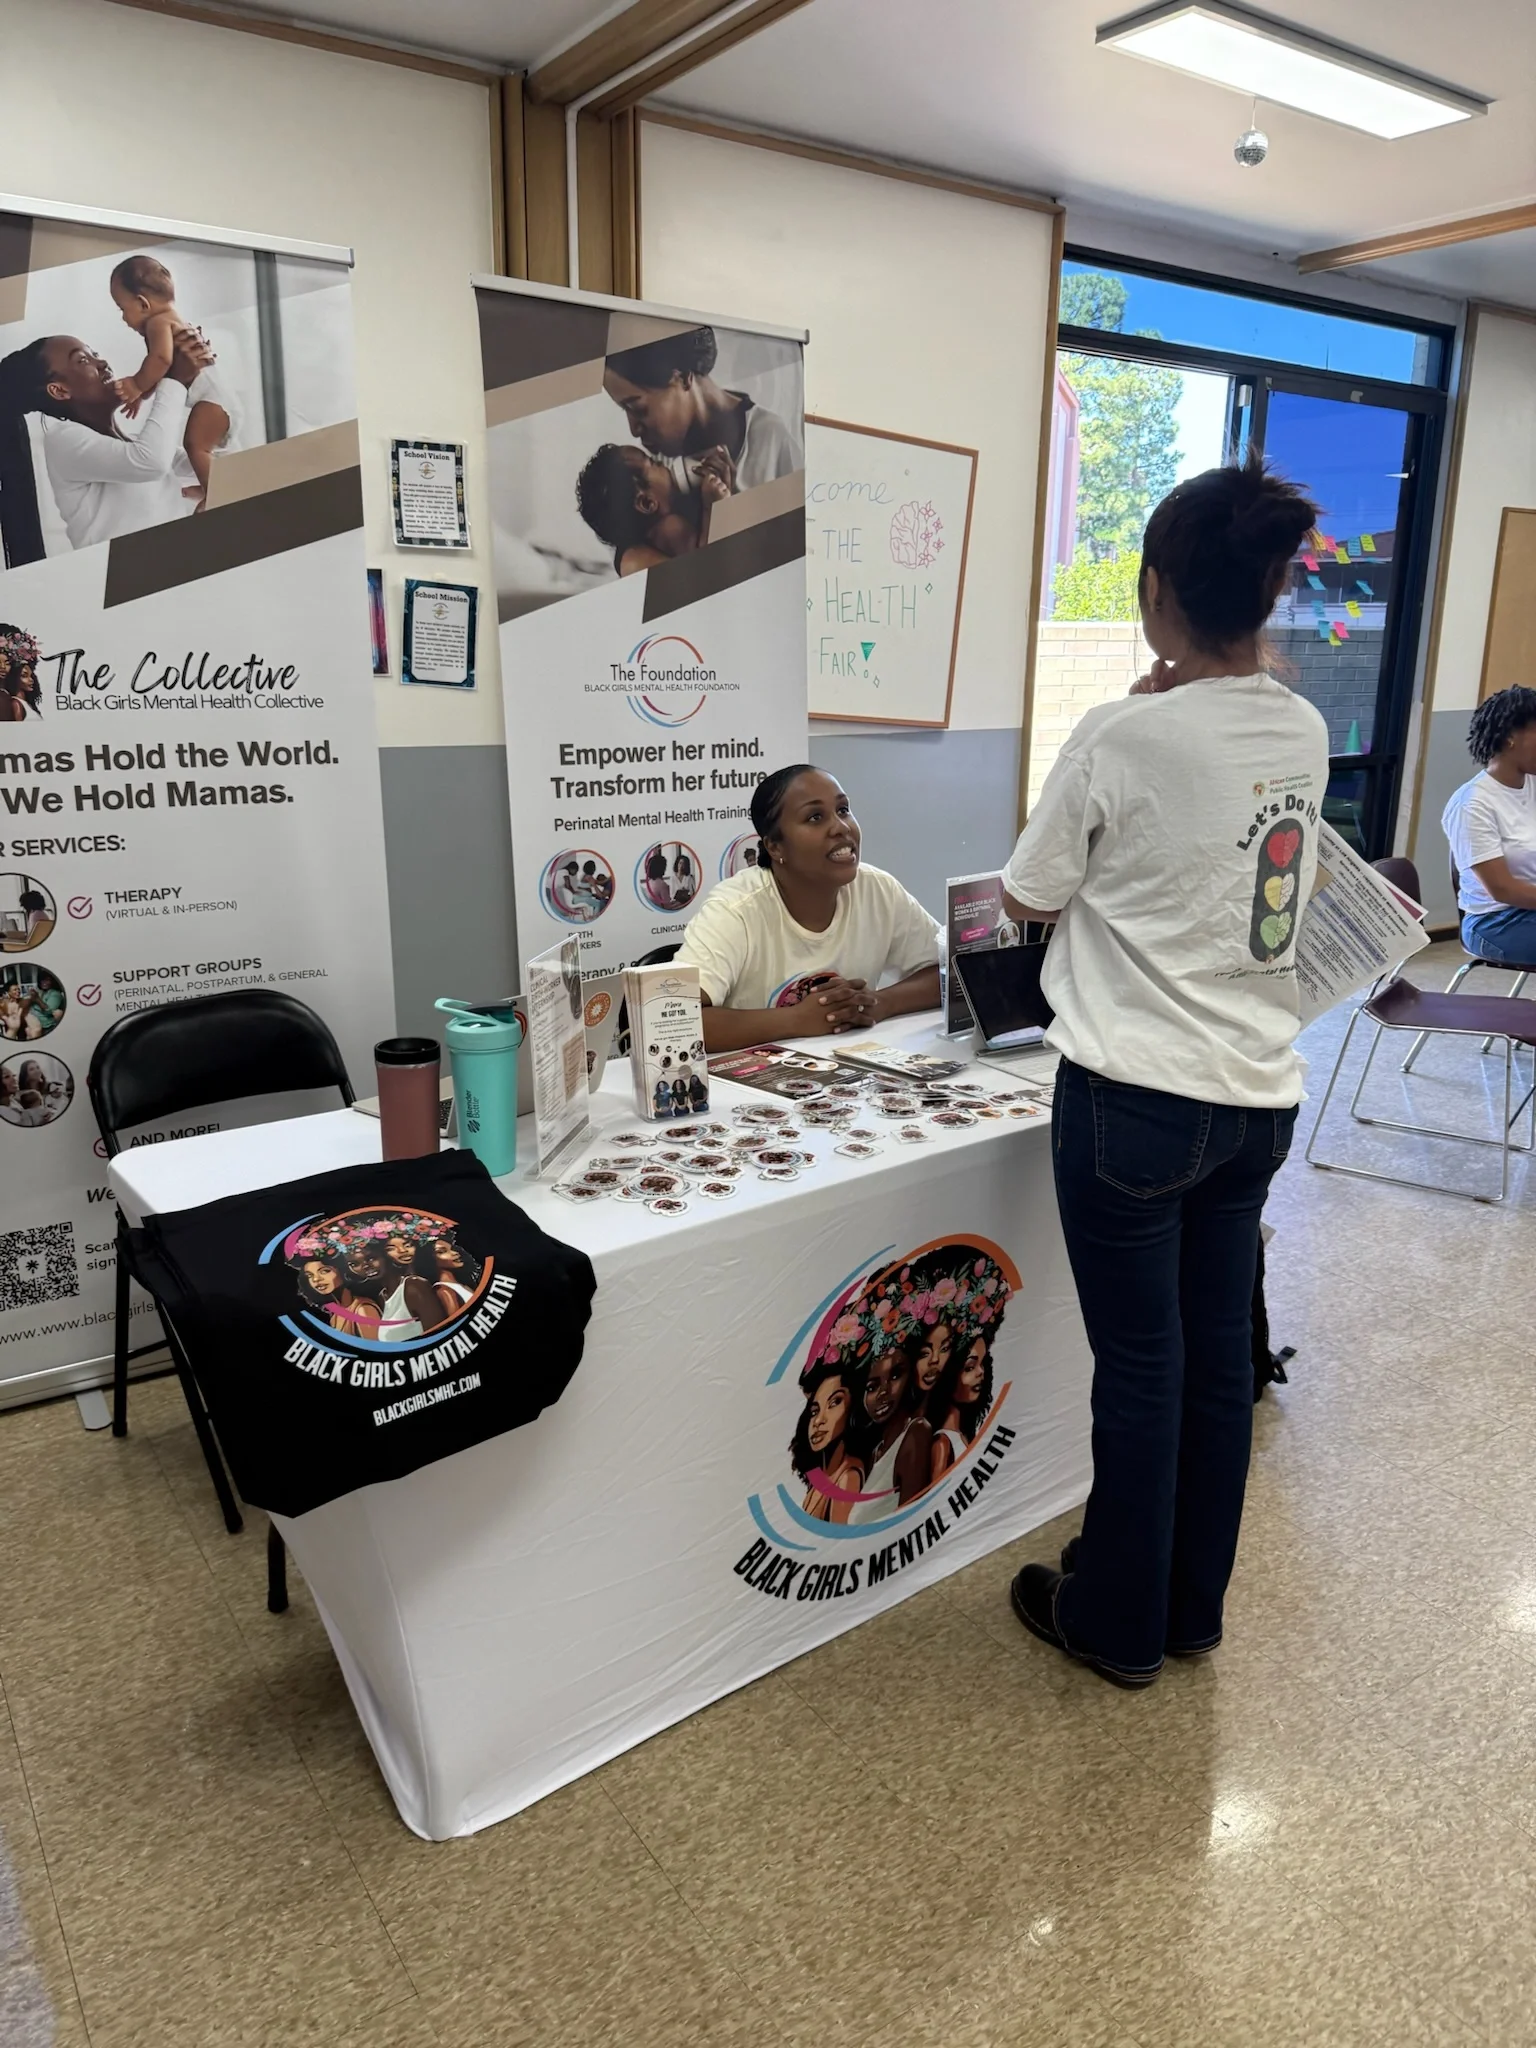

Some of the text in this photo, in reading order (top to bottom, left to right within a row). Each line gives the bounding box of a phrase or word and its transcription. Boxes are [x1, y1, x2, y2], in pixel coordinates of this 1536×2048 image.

[404, 451, 450, 461] School Vision
[822, 528, 862, 563] THE
[415, 591, 469, 603] School Mission
[825, 576, 916, 628] HEALTH
[41, 648, 300, 694] The Collective
[610, 663, 716, 681] The Foundation
[584, 683, 741, 692] BLACK GIRLS MENTAL HEALTH FOUNDATION
[56, 693, 324, 711] Black Girls Mental Health Collective
[85, 743, 166, 771] Hold
[175, 742, 229, 769] the
[237, 740, 340, 766] World.
[559, 737, 765, 770] Empower her mind.
[0, 780, 294, 815] We Hold Mamas.
[550, 774, 665, 799] Transform
[672, 771, 705, 792] her
[554, 812, 615, 832] Perinatal
[618, 810, 662, 827] Mental
[665, 808, 705, 823] Health
[1236, 803, 1280, 851] Let's
[1285, 794, 1305, 812] Do
[11, 835, 126, 857] SERVICES:
[104, 886, 183, 904] THERAPY
[106, 900, 238, 921] (VIRTUAL & IN-PERSON)
[113, 957, 262, 984] SUPPORT GROUPS
[114, 983, 184, 1001] (PERINATAL,
[187, 973, 266, 991] POSTPARTUM,
[268, 972, 276, 982] &
[278, 968, 328, 981] GENERAL
[130, 1132, 165, 1148] AND
[86, 1186, 116, 1203] We
[284, 1273, 518, 1388] BLACK GIRLS MENTAL HEALTH
[373, 1372, 481, 1427] BLACKGIRLSMHC.COM
[733, 1424, 1017, 1602] BLACK GIRLS MENTAL HEALTH
